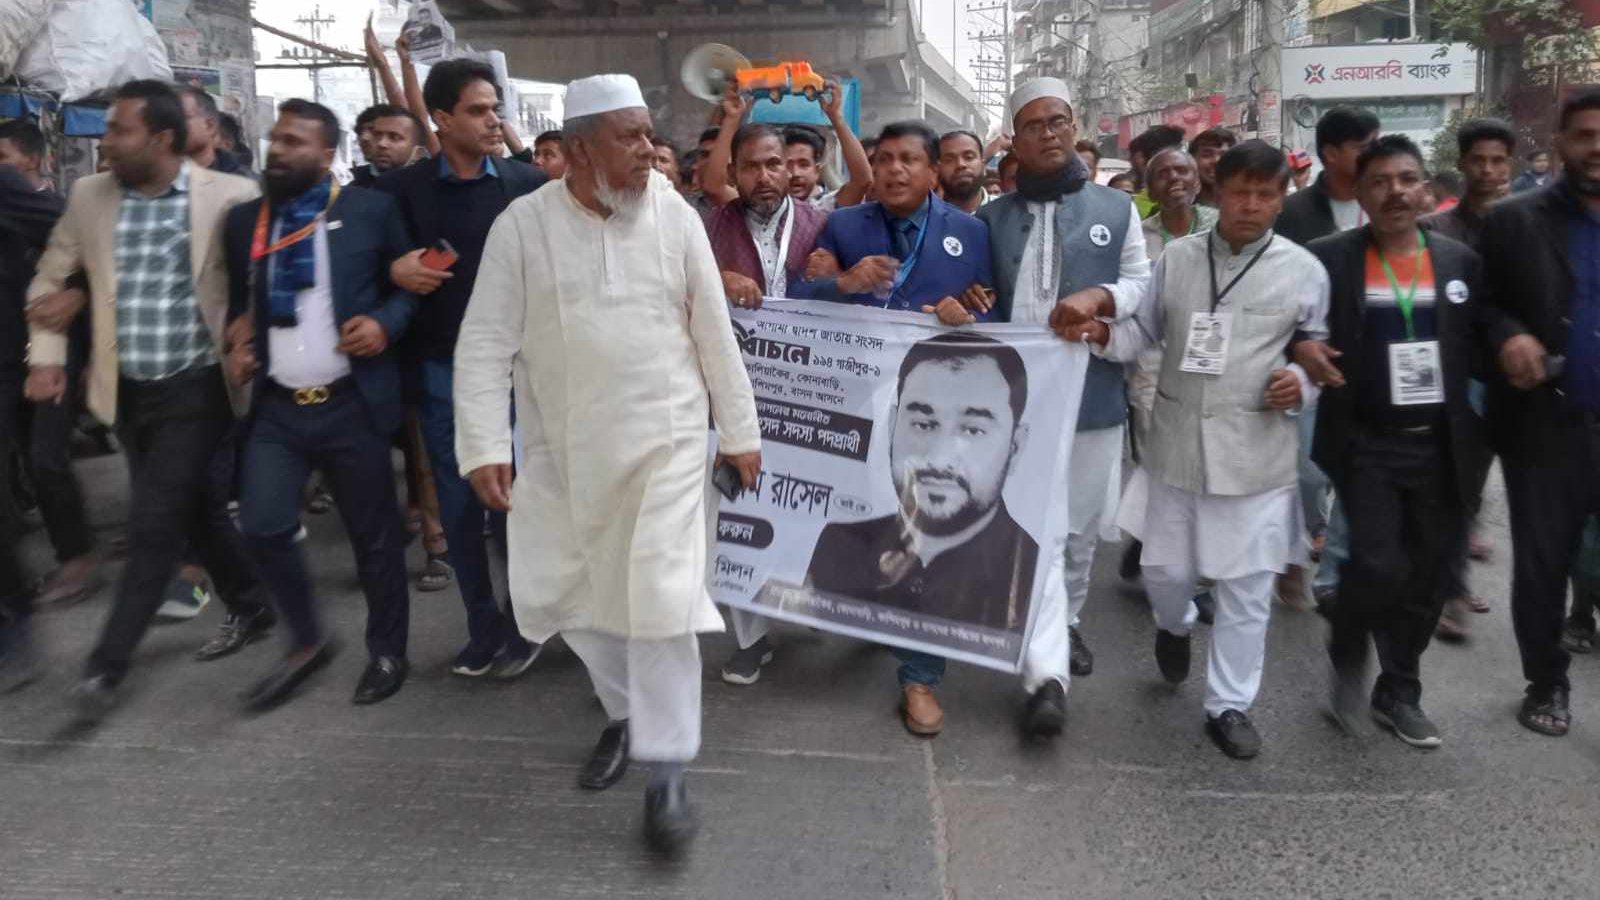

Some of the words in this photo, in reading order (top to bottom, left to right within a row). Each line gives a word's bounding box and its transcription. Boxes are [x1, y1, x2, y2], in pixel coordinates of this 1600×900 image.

[1331, 60, 1404, 82] এনআরবি
[1407, 63, 1452, 79] ব্যাংক
[855, 334, 885, 351] সংসদ
[783, 420, 815, 444] সদস্য
[771, 471, 834, 518] রাসেল
